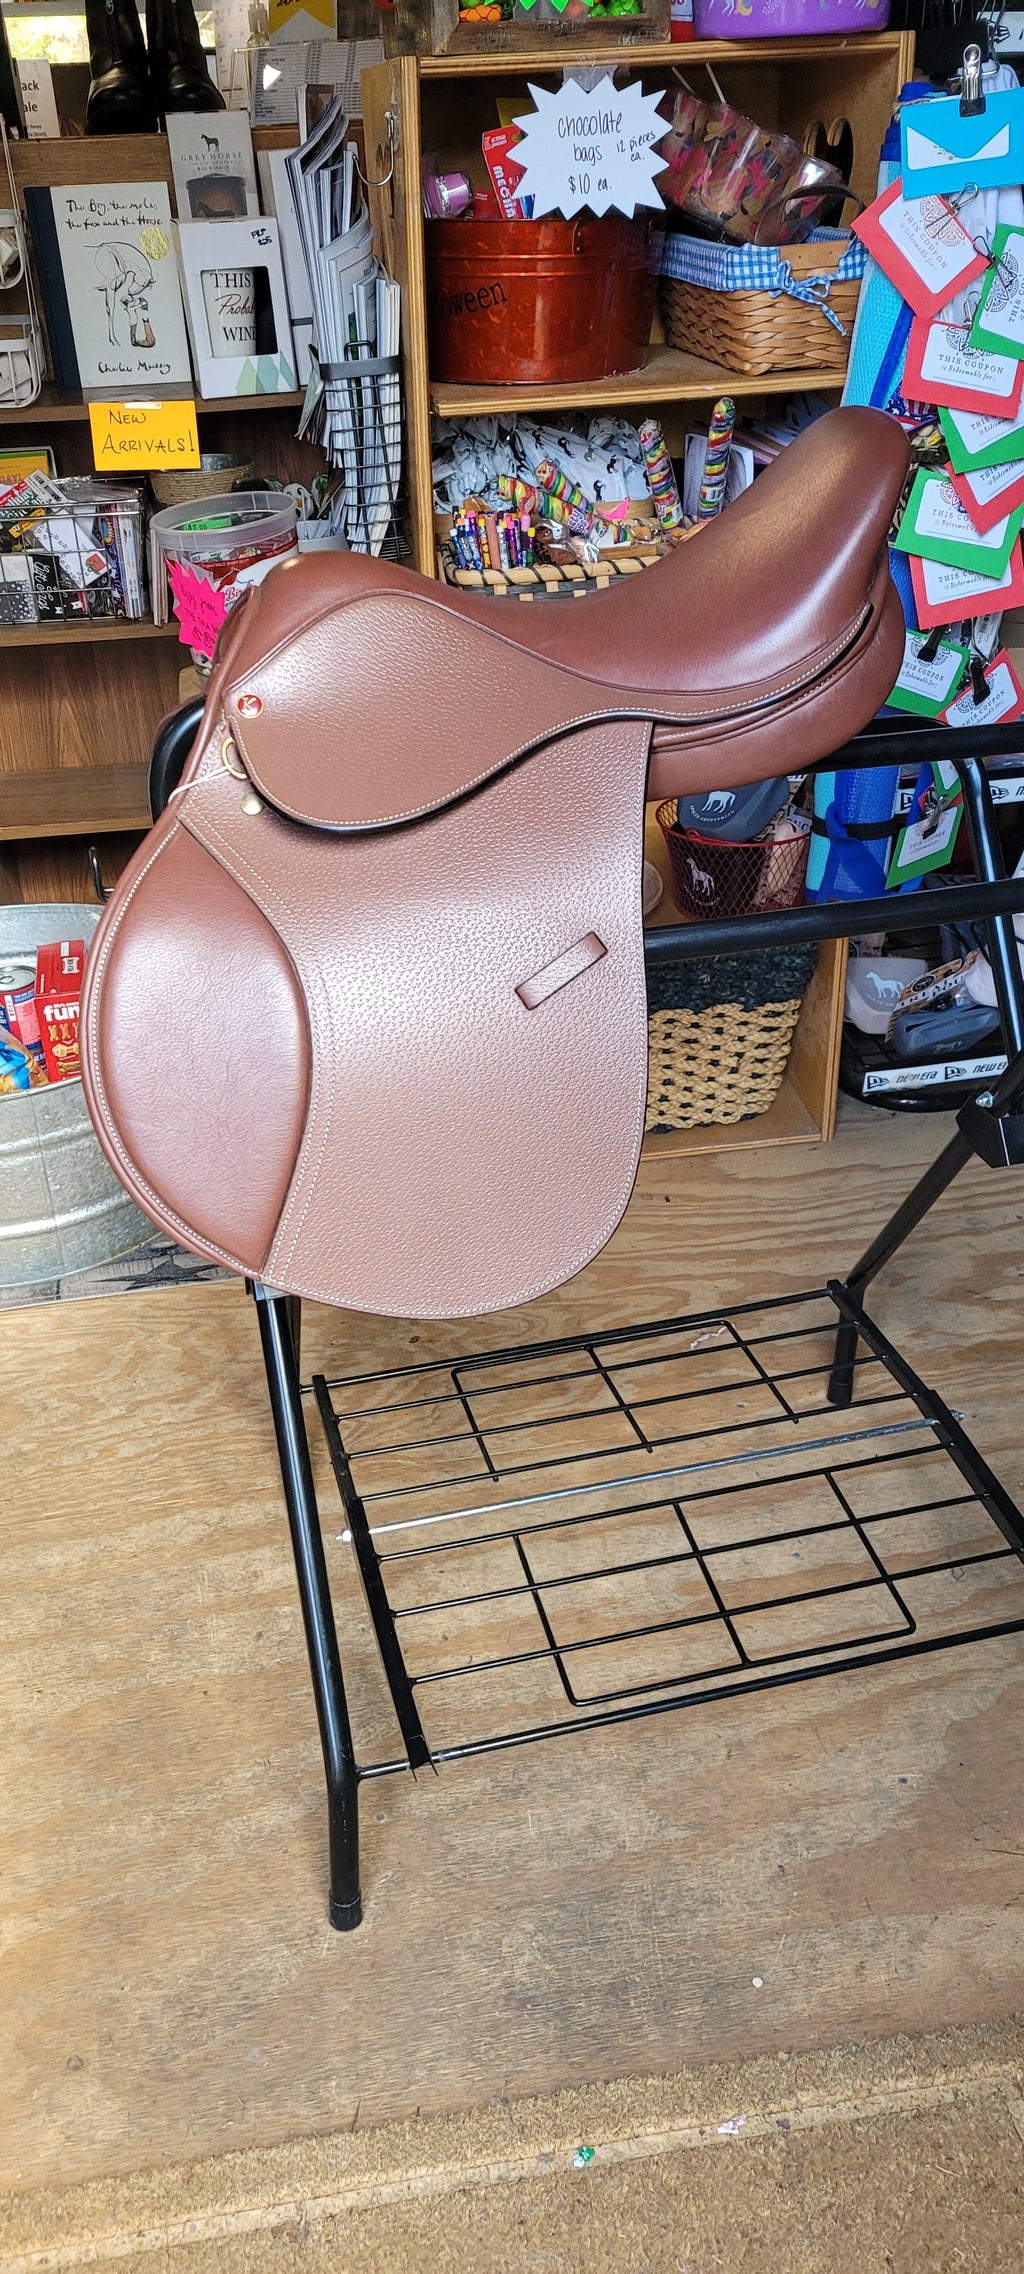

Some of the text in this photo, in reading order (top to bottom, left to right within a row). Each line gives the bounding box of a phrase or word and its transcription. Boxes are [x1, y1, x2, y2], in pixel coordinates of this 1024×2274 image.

[558, 110, 623, 138] chocolate
[616, 130, 656, 154] 12 pieces
[209, 152, 243, 160] HORSE
[573, 143, 603, 166] bags
[630, 151, 645, 161] ea.
[568, 172, 612, 194] $10 ea.
[65, 199, 84, 213] The
[110, 200, 127, 210] the
[65, 218, 81, 229] the
[83, 217, 101, 230] fox
[102, 218, 119, 226] and
[120, 215, 135, 226] the
[920, 233, 948, 268] COUPON
[210, 272, 251, 288] THIS
[939, 354, 1003, 374] THIS COUPON
[109, 409, 147, 425] NEW
[101, 432, 197, 455] ARRIVALS!
[932, 508, 954, 519] THIS
[938, 573, 960, 583] THIS
